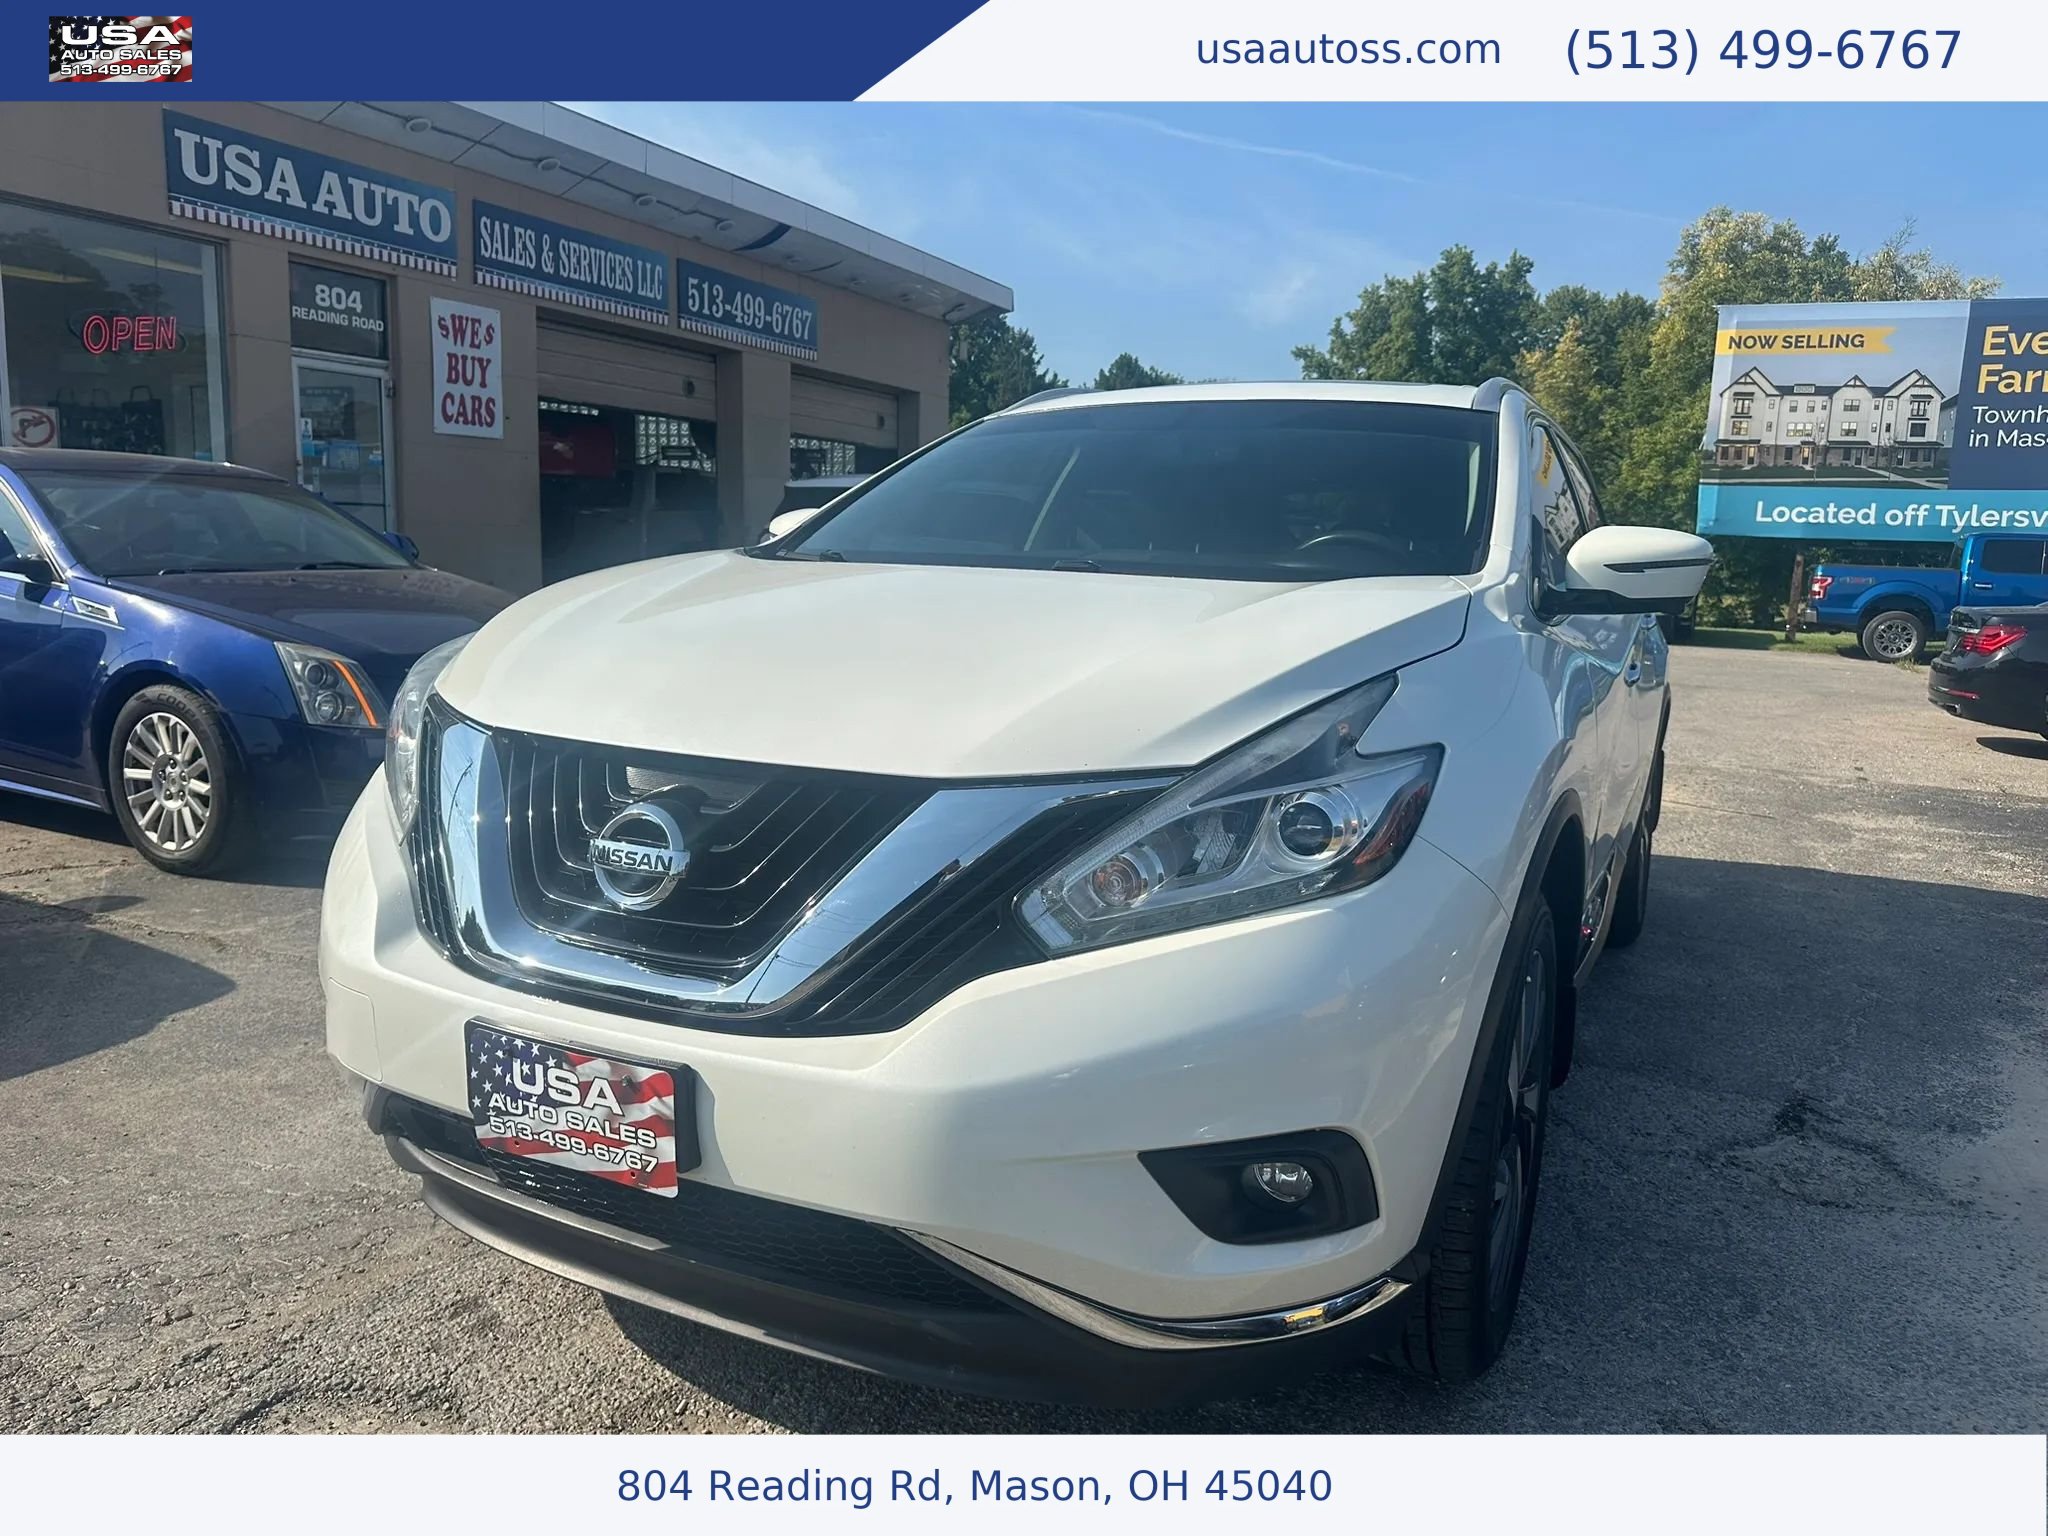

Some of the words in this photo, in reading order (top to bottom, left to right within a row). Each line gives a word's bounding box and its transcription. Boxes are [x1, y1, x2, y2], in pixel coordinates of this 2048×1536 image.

[174, 128, 306, 208] USA
[312, 171, 452, 243] AUTO
[479, 215, 536, 270] SALES
[541, 233, 555, 274] &
[559, 238, 633, 293] SERVICES
[637, 258, 663, 301] LLC
[314, 284, 363, 313] 804
[687, 276, 813, 341] 513-499-6767
[83, 314, 177, 355] OPEN
[291, 305, 349, 326] READING
[352, 316, 384, 332] ROAD
[1728, 335, 1778, 350] NOW
[1781, 333, 1865, 350] SELLING
[446, 352, 491, 388] BUY
[1977, 363, 2048, 394] Far
[441, 391, 496, 428] CARS
[1968, 429, 1989, 447] in
[1996, 429, 2048, 447] Mas
[1755, 500, 1876, 525] Located
[1884, 502, 1928, 528] off
[591, 844, 673, 872] NISSAN
[512, 1057, 625, 1116] USA
[488, 1093, 557, 1124] AUTO
[565, 1111, 656, 1148] SALES
[489, 1116, 658, 1173] 513-499-6767
